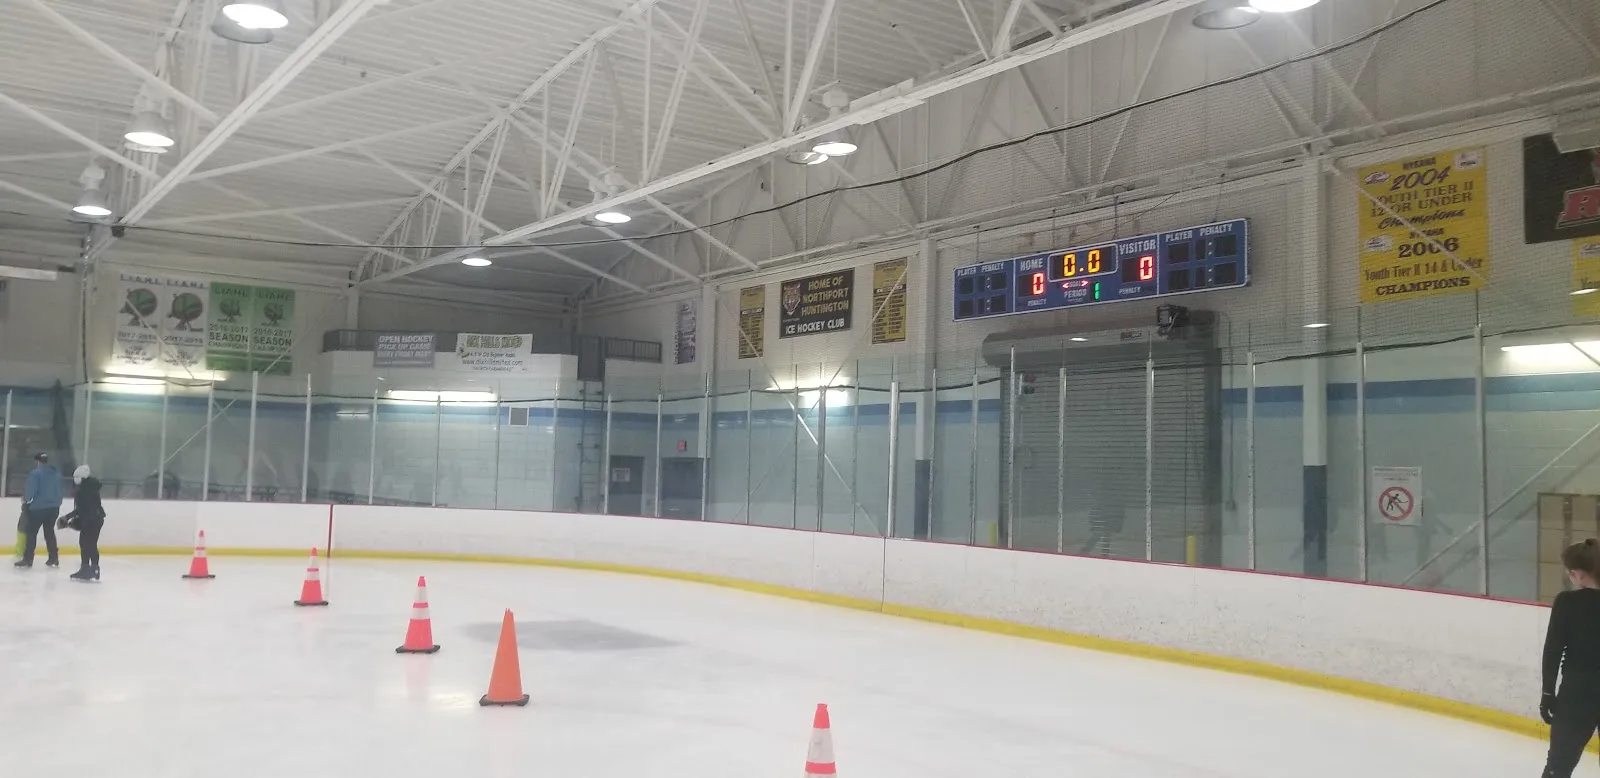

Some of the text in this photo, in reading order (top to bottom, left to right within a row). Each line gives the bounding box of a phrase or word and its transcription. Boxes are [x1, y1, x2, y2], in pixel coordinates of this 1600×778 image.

[1390, 166, 1451, 191] 2004
[1424, 184, 1458, 198] TIER
[1418, 192, 1472, 209] UNDER
[1377, 208, 1466, 230] Champions
[1165, 223, 1232, 242] PLAYER PENALTY
[1119, 239, 1156, 255] VISITOR
[1398, 238, 1459, 258] 2006
[957, 262, 1004, 276] PLAYER PENALTY
[1020, 258, 1044, 272] HOME
[1139, 256, 1153, 281] 0
[1364, 268, 1390, 281] Youth
[1392, 266, 1411, 277] Tier
[1425, 262, 1437, 274] 14
[808, 276, 844, 291] HOME OF
[1032, 272, 1045, 296] 0
[1118, 286, 1141, 295] PENALTY
[1376, 277, 1470, 295] CHAMPIONS
[803, 288, 849, 304] NORTHPORT
[1063, 288, 1087, 299] PERIOD
[801, 300, 849, 316] HUNTINGTON
[785, 318, 845, 335] ICE HOCKEY CLUB
[208, 332, 248, 342] SEASON
[253, 336, 292, 347] SEASON
[401, 335, 433, 343] HOCKEY
